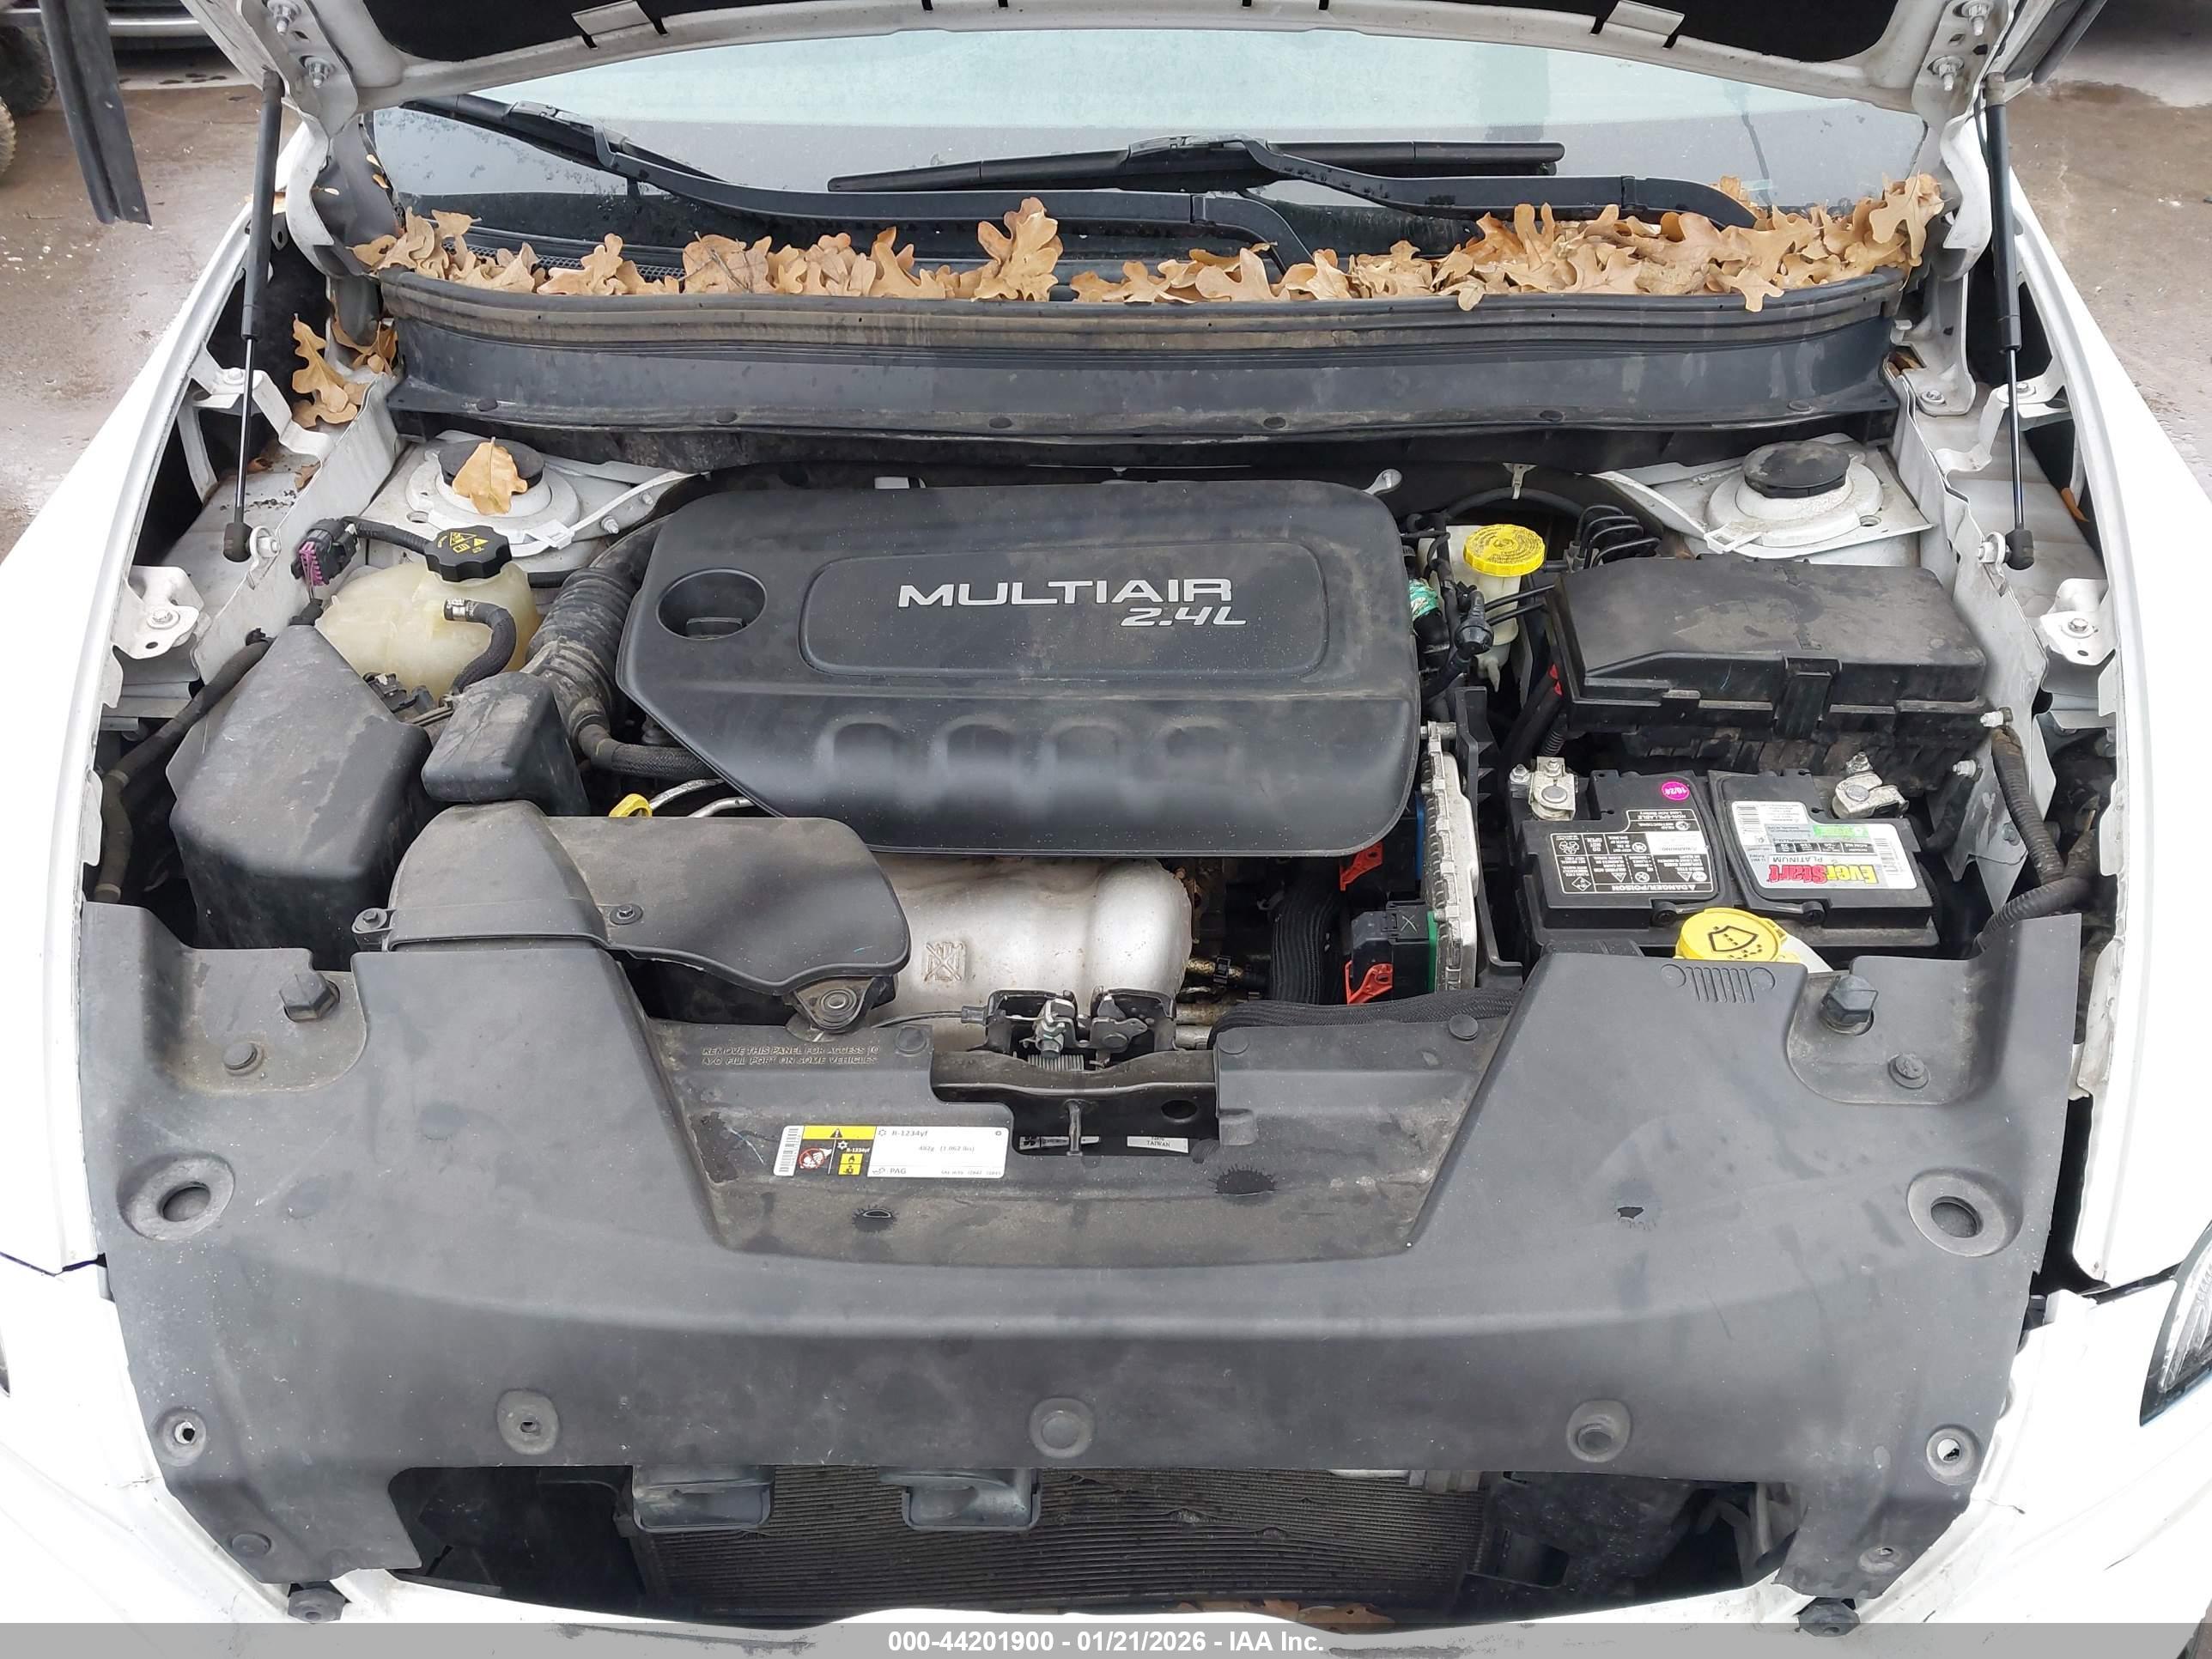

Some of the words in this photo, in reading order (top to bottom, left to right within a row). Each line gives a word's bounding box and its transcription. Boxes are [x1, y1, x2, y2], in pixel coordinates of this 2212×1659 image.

[897, 578, 1233, 608] MULTIAIR
[1120, 605, 1247, 627] 2.4L
[1768, 864, 1879, 884] EverStart
[702, 1046, 745, 1056] REMOVE
[746, 1046, 770, 1056] THIS
[771, 1046, 803, 1055] PANEL
[805, 1046, 825, 1055] FOR
[827, 1046, 865, 1055] ACCESS
[702, 1056, 722, 1066] A/C
[726, 1056, 746, 1066] FILL
[750, 1056, 776, 1066] PORT
[779, 1056, 795, 1065] ON
[797, 1056, 825, 1065] SOME
